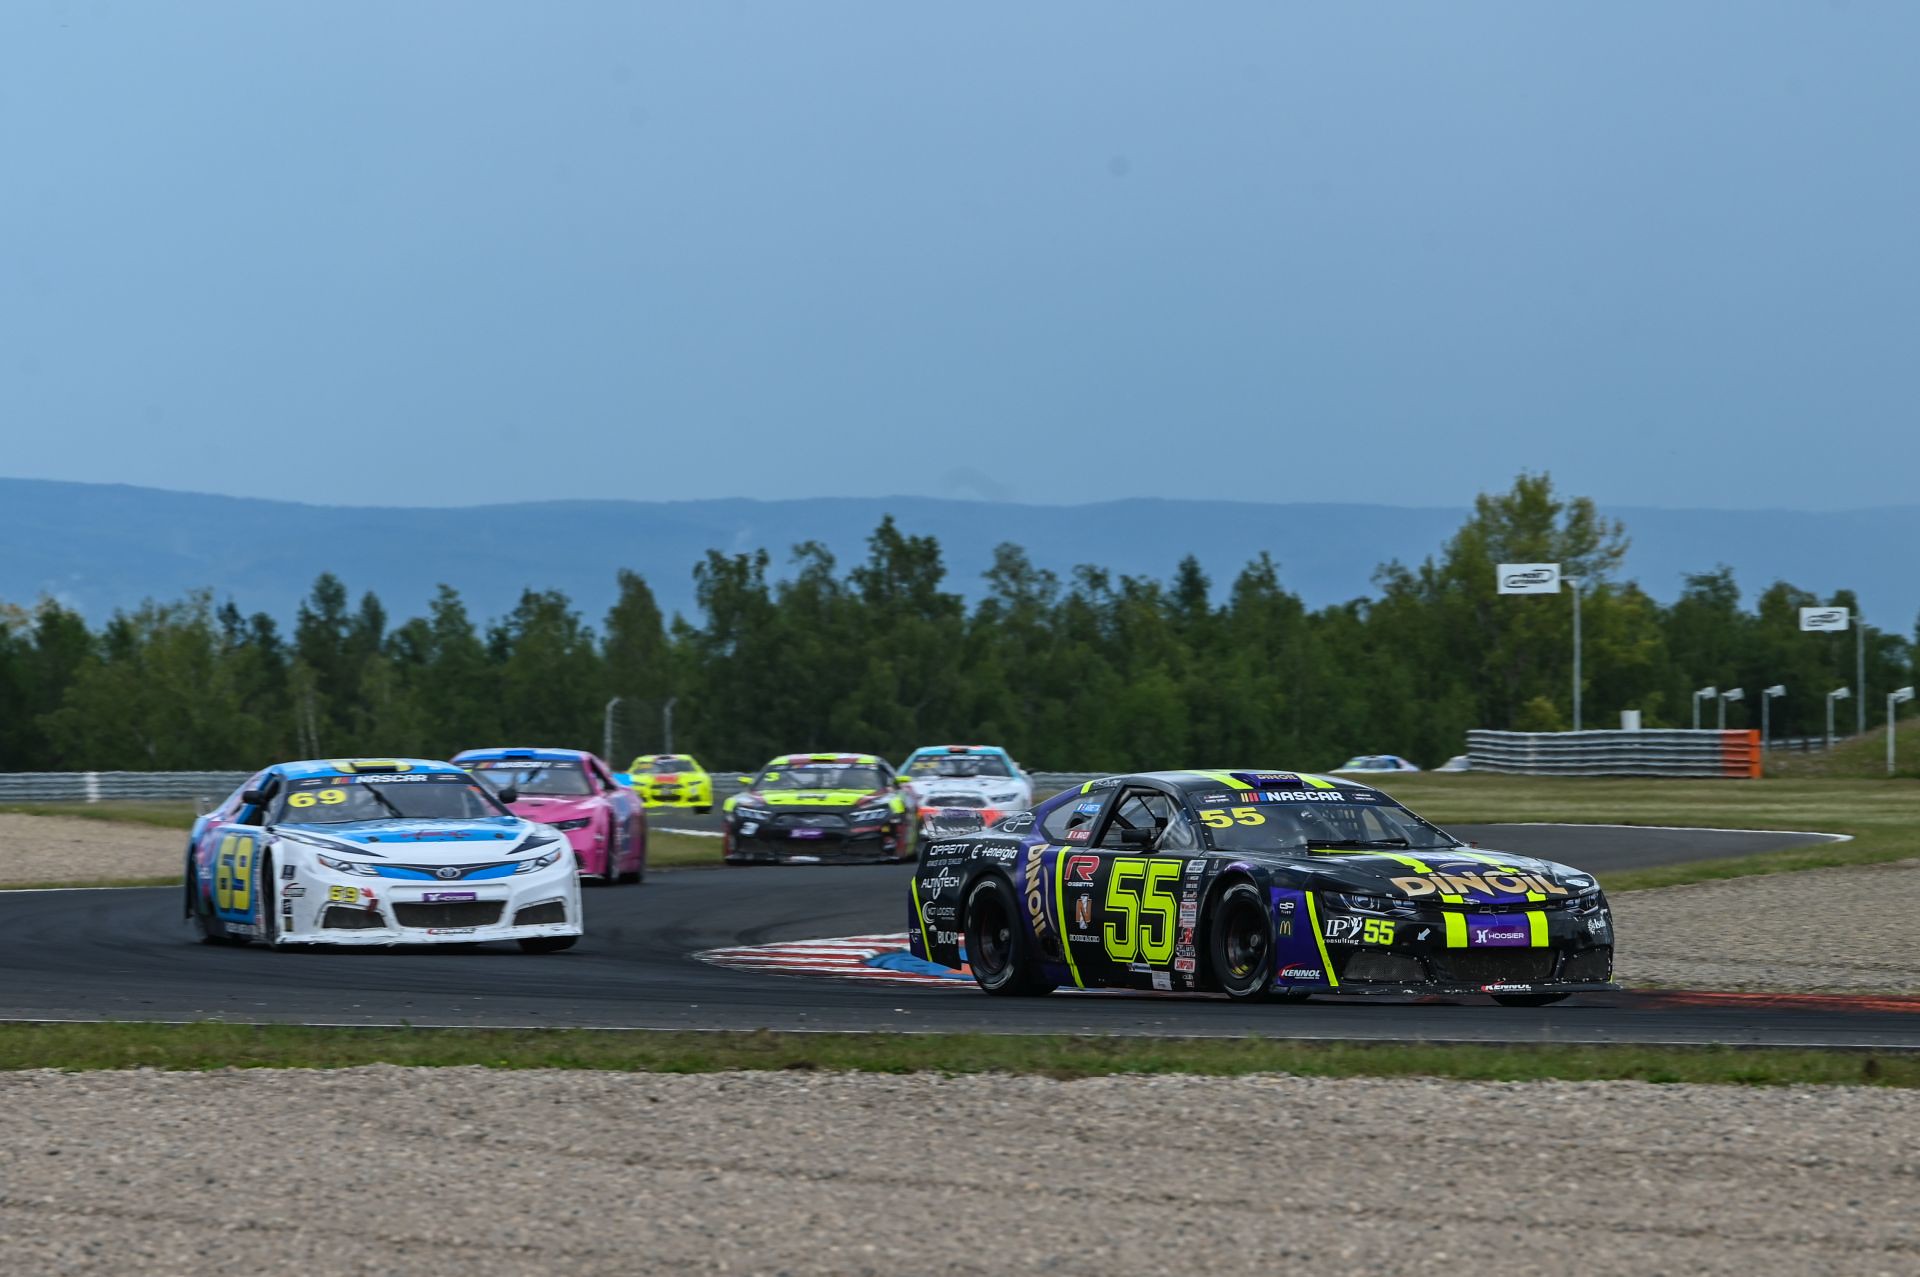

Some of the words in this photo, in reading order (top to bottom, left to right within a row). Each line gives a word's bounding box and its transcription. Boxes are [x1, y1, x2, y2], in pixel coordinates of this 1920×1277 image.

[355, 774, 428, 783] NASCAR
[287, 789, 347, 808] 69
[1266, 792, 1345, 801] NASCAR
[1199, 806, 1266, 828] 55
[216, 835, 253, 911] 69
[329, 885, 360, 903] 69
[1025, 843, 1050, 938] DINOIL
[1389, 871, 1569, 897] DINOIL
[1103, 857, 1183, 966] 55
[1363, 918, 1396, 945] 55
[1488, 932, 1525, 940] HOOSIER
[1281, 969, 1320, 977] KENNOL
